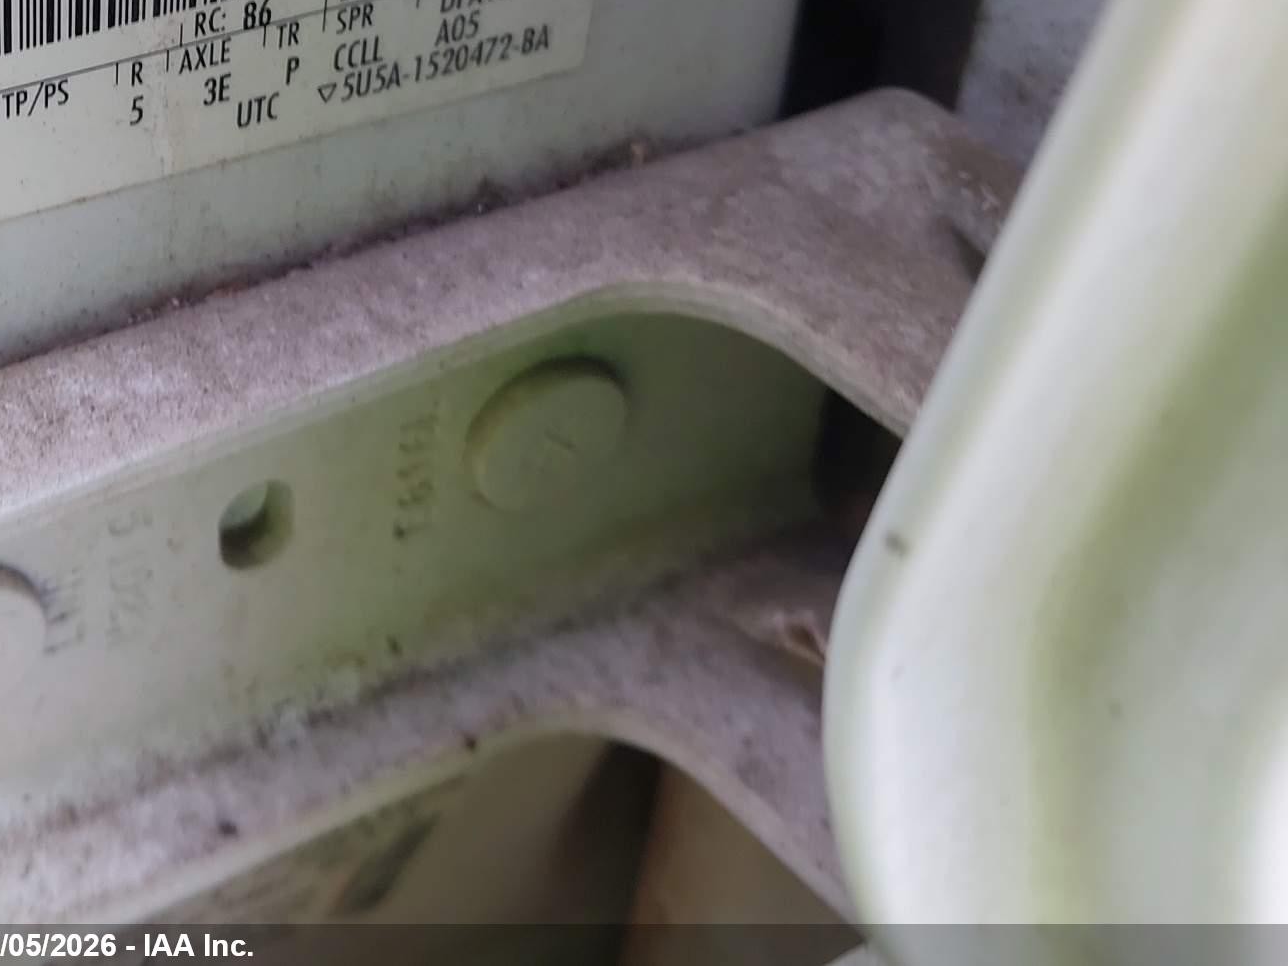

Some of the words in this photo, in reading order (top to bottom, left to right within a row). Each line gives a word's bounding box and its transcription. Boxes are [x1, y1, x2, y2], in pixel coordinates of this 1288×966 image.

[193, 7, 226, 38] RC:
[275, 21, 300, 51] TR
[336, 2, 375, 36] SPR
[178, 36, 232, 76] AXLE
[285, 55, 300, 87] P
[333, 35, 384, 73] CCLL
[129, 60, 144, 87] R
[202, 72, 233, 108] 3E
[1, 78, 69, 120] TP/PS
[129, 95, 144, 126] 5
[236, 91, 281, 129] UTC
